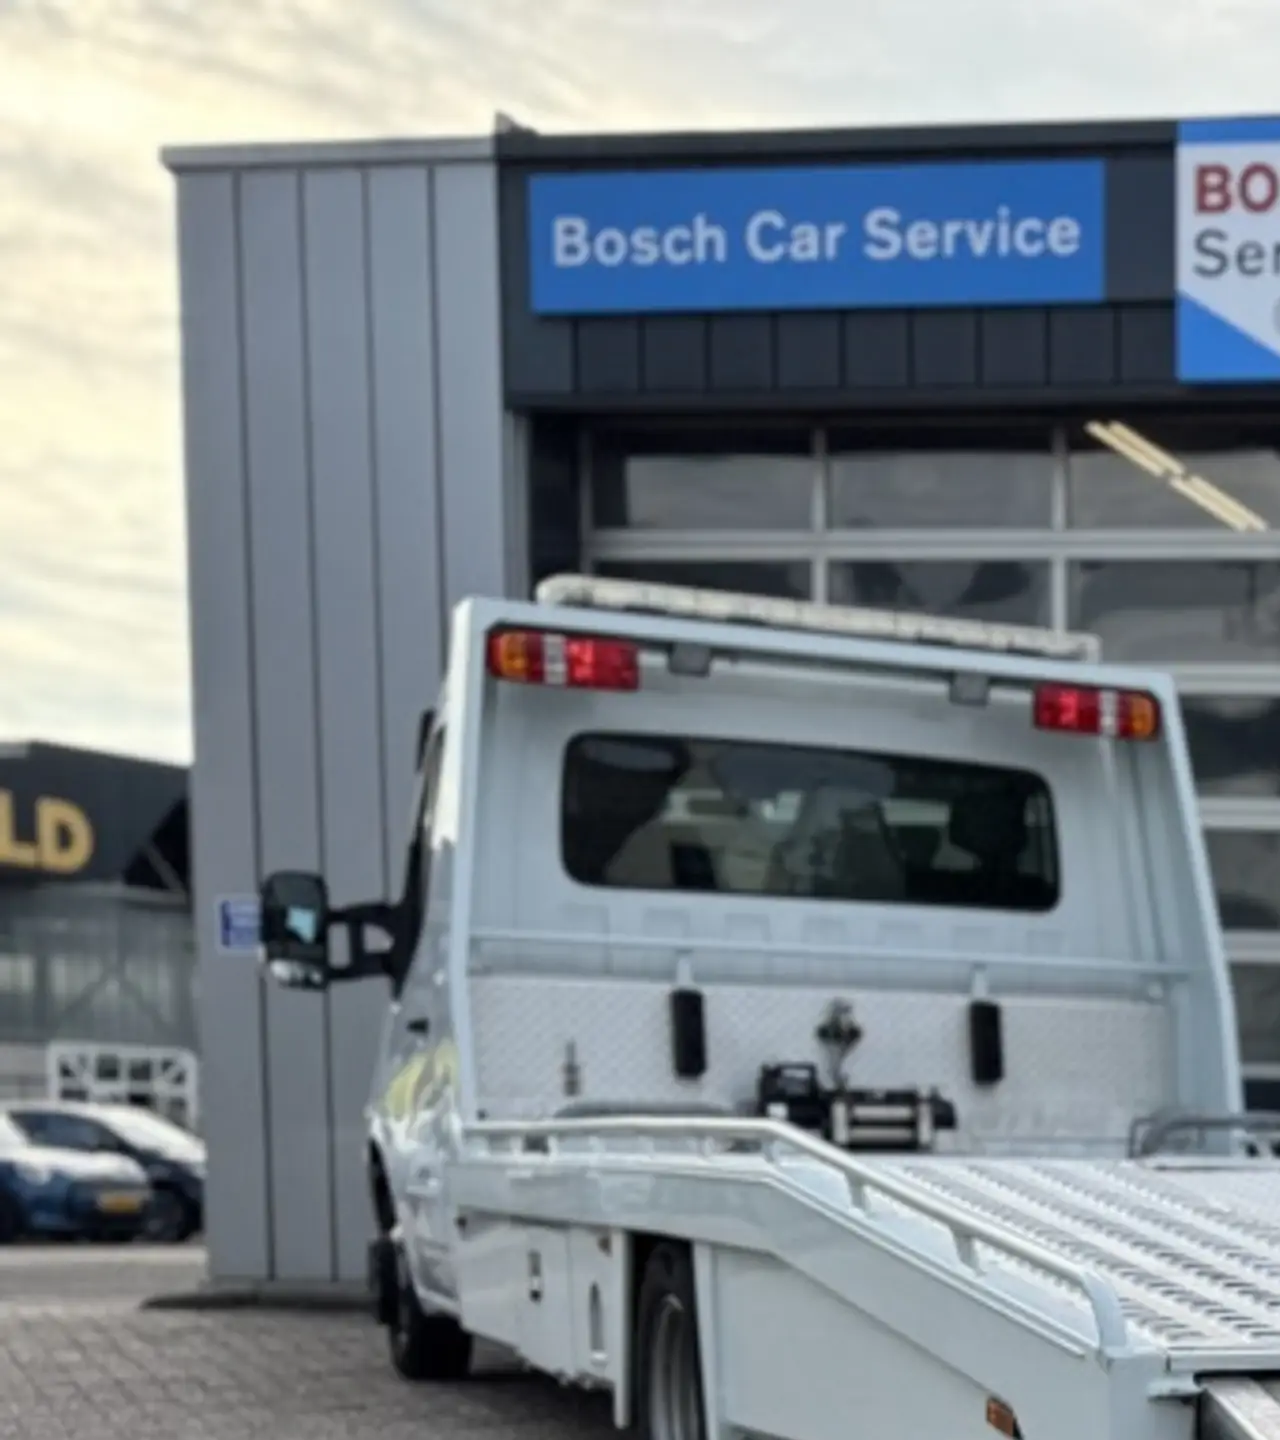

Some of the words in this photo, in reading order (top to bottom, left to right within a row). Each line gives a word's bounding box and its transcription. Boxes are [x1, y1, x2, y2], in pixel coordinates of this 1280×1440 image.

[552, 215, 726, 267] Bosch
[745, 210, 847, 263] Car
[863, 207, 1081, 260] Service
